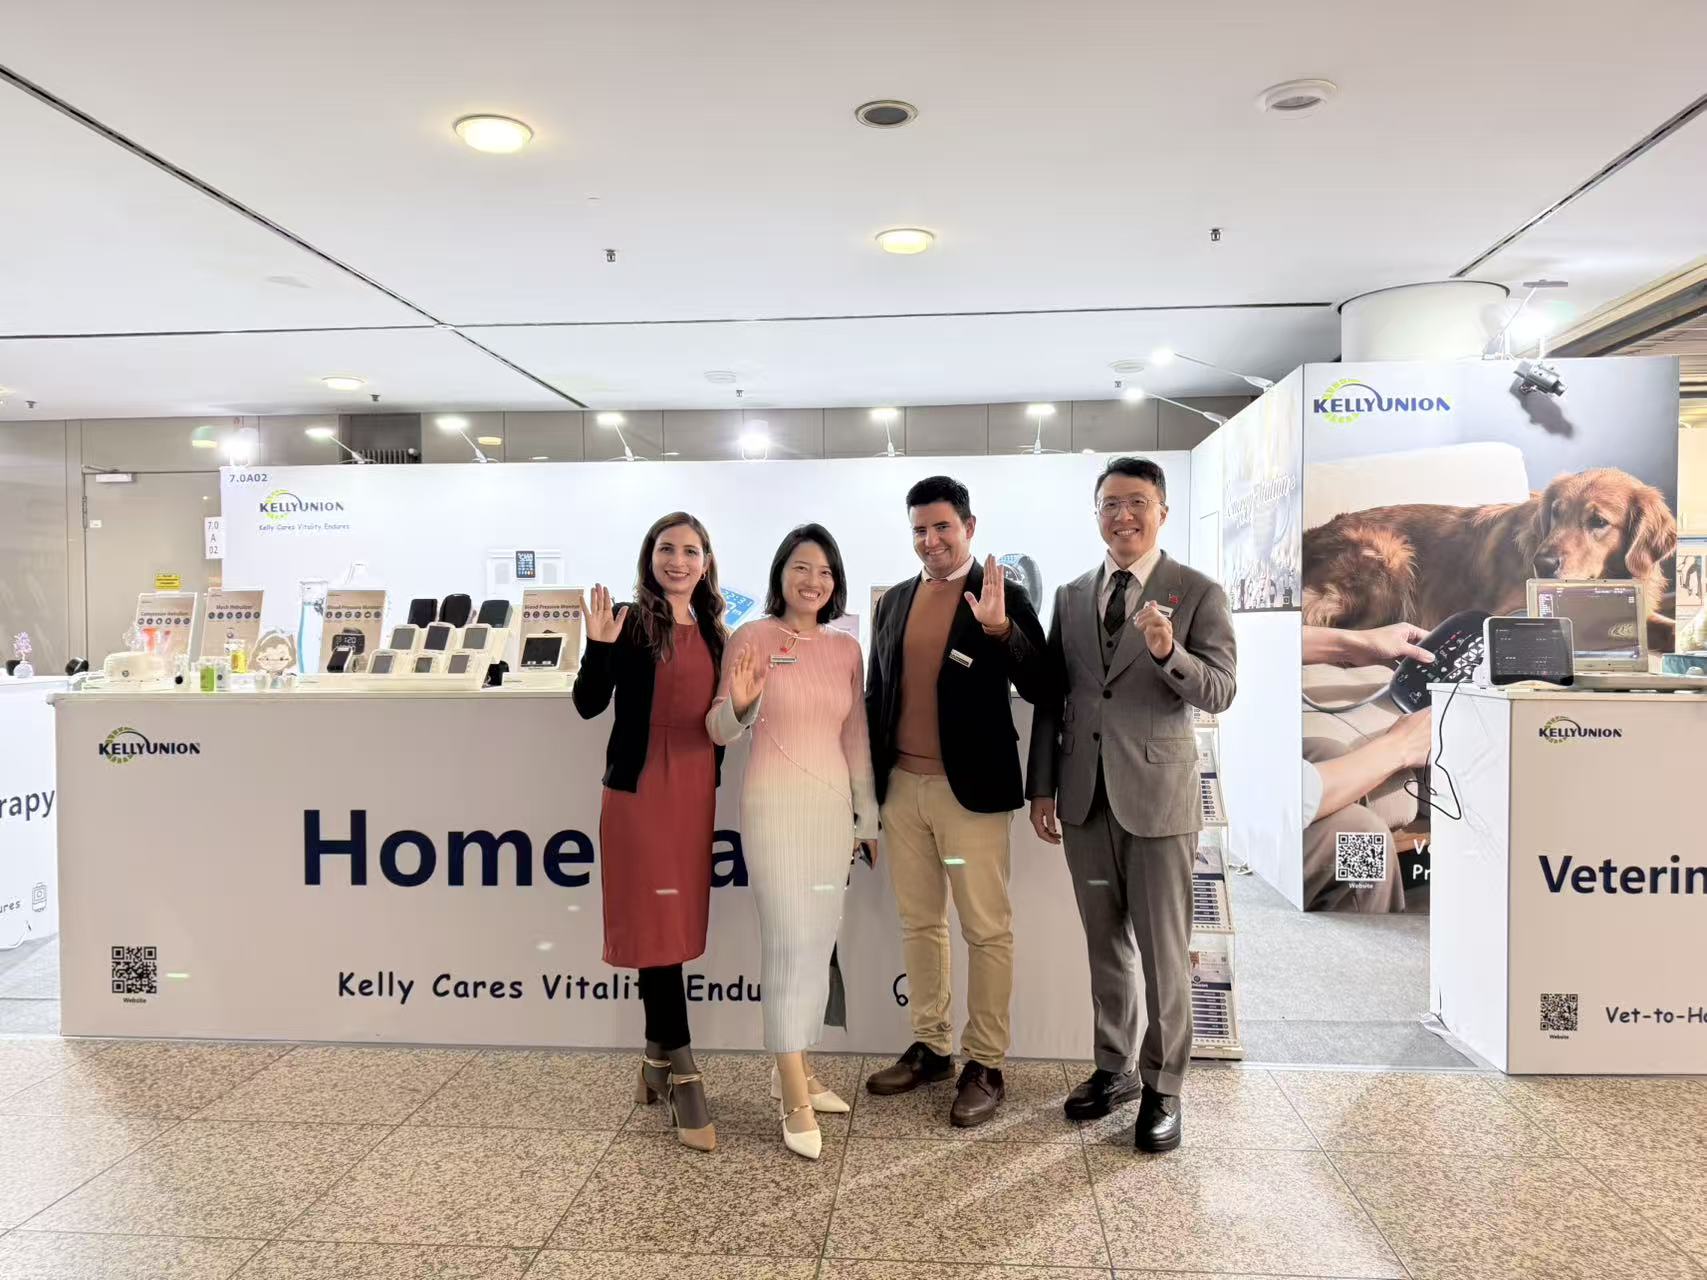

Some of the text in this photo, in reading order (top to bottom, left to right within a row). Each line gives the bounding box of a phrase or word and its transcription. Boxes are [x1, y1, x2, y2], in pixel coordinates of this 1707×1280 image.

[1313, 396, 1451, 414] KELLYUNION
[229, 473, 268, 483] 7.0A02
[259, 501, 345, 513] KELLYUNION
[210, 533, 216, 542] A
[208, 545, 219, 554] 02
[1538, 727, 1622, 738] KELLYUNION
[98, 742, 200, 755] KELLYUNION
[303, 809, 595, 888] Home
[1538, 854, 1707, 895] Veterin
[338, 970, 414, 1005] Kelly
[432, 973, 523, 999] Cares
[686, 974, 761, 1002] Endu
